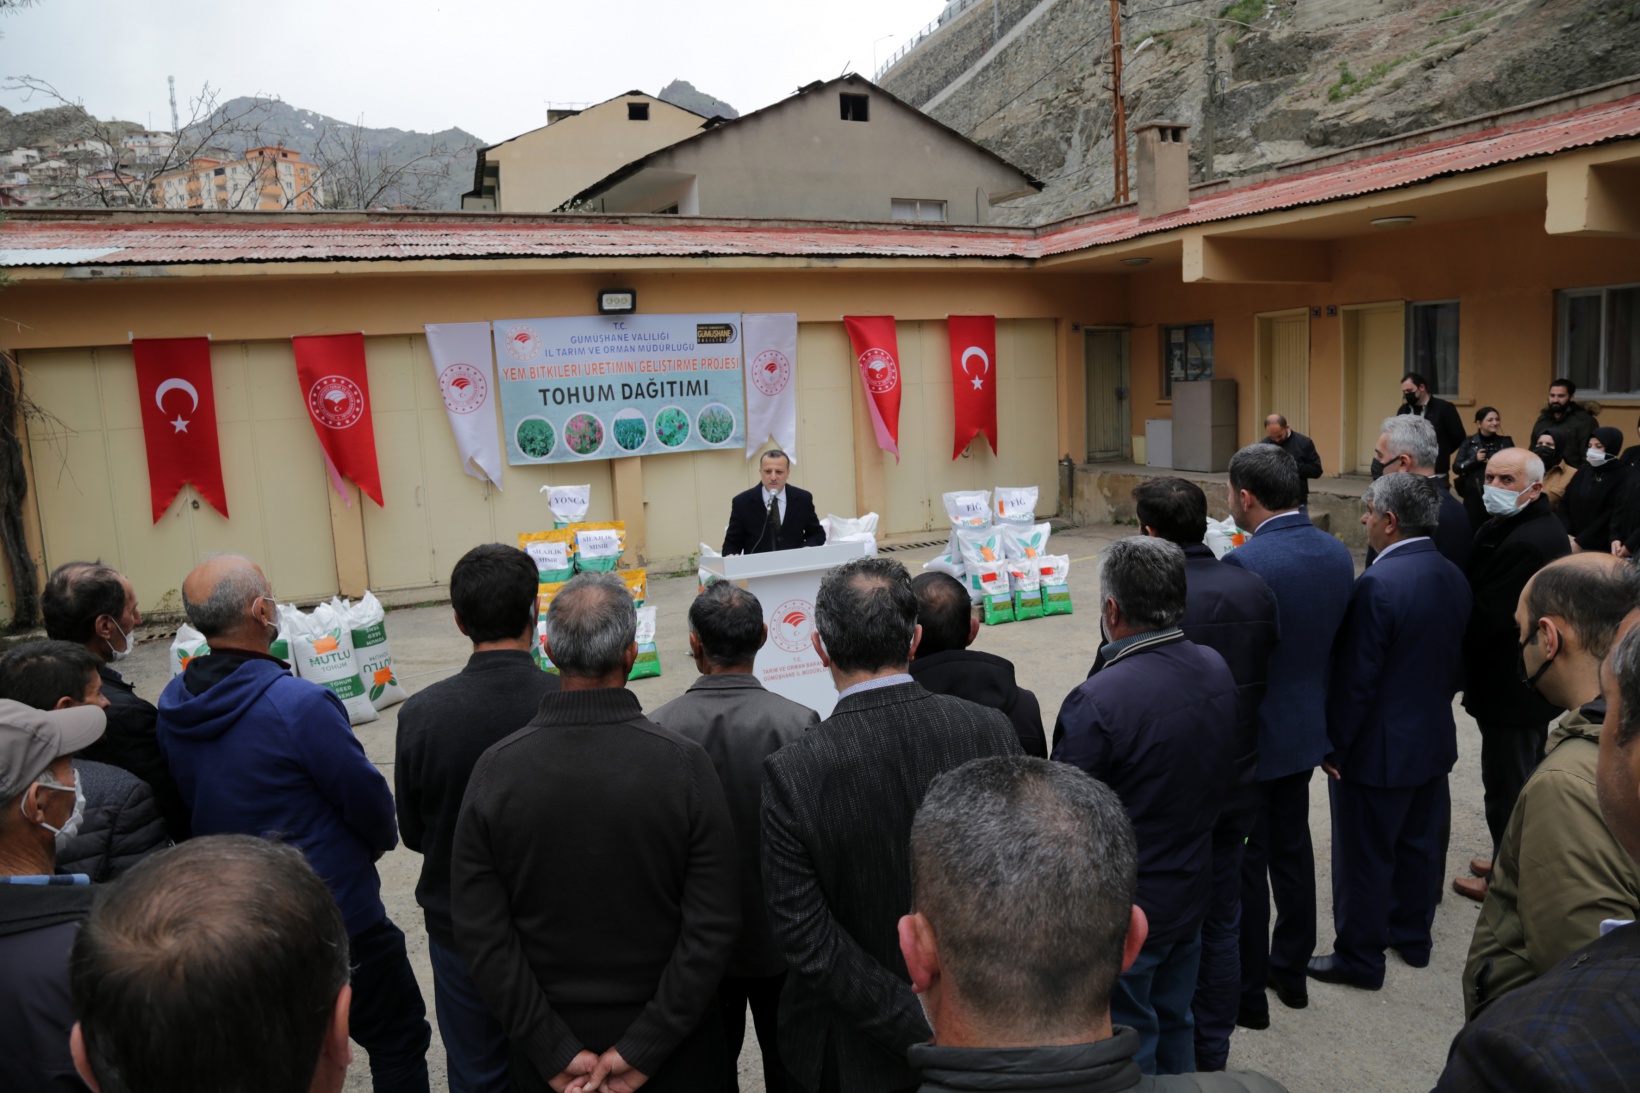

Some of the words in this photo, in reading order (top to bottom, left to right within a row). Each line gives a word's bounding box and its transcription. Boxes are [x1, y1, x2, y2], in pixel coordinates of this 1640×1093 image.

[613, 322, 628, 331] T.C.
[570, 332, 629, 345] GÜMÜŞHANE
[632, 331, 670, 341] VALİLİĞİ
[545, 346, 554, 357] İL
[556, 347, 586, 356] TARIM
[588, 345, 601, 354] VE
[603, 343, 636, 354] ORMAN
[637, 342, 695, 353] MÜDÜRLÜĞÜ
[502, 367, 527, 381] YEM
[529, 362, 582, 380] BİTKİLERİ
[584, 359, 637, 376] ÜRETİMİNİ
[639, 357, 698, 375] GELİŞTİRME
[701, 356, 740, 370] PROJESİ
[538, 384, 615, 406] TOHUM
[621, 377, 709, 400] DAĞITIMI
[554, 496, 586, 505] YONCA
[589, 543, 609, 551] MISIR
[366, 636, 385, 646] TOHUM
[309, 649, 350, 667] MUTLU
[322, 662, 347, 672] TOHUM
[787, 663, 806, 671] ORMAN
[330, 678, 352, 687] TOHUM
[335, 685, 352, 693] SEED
